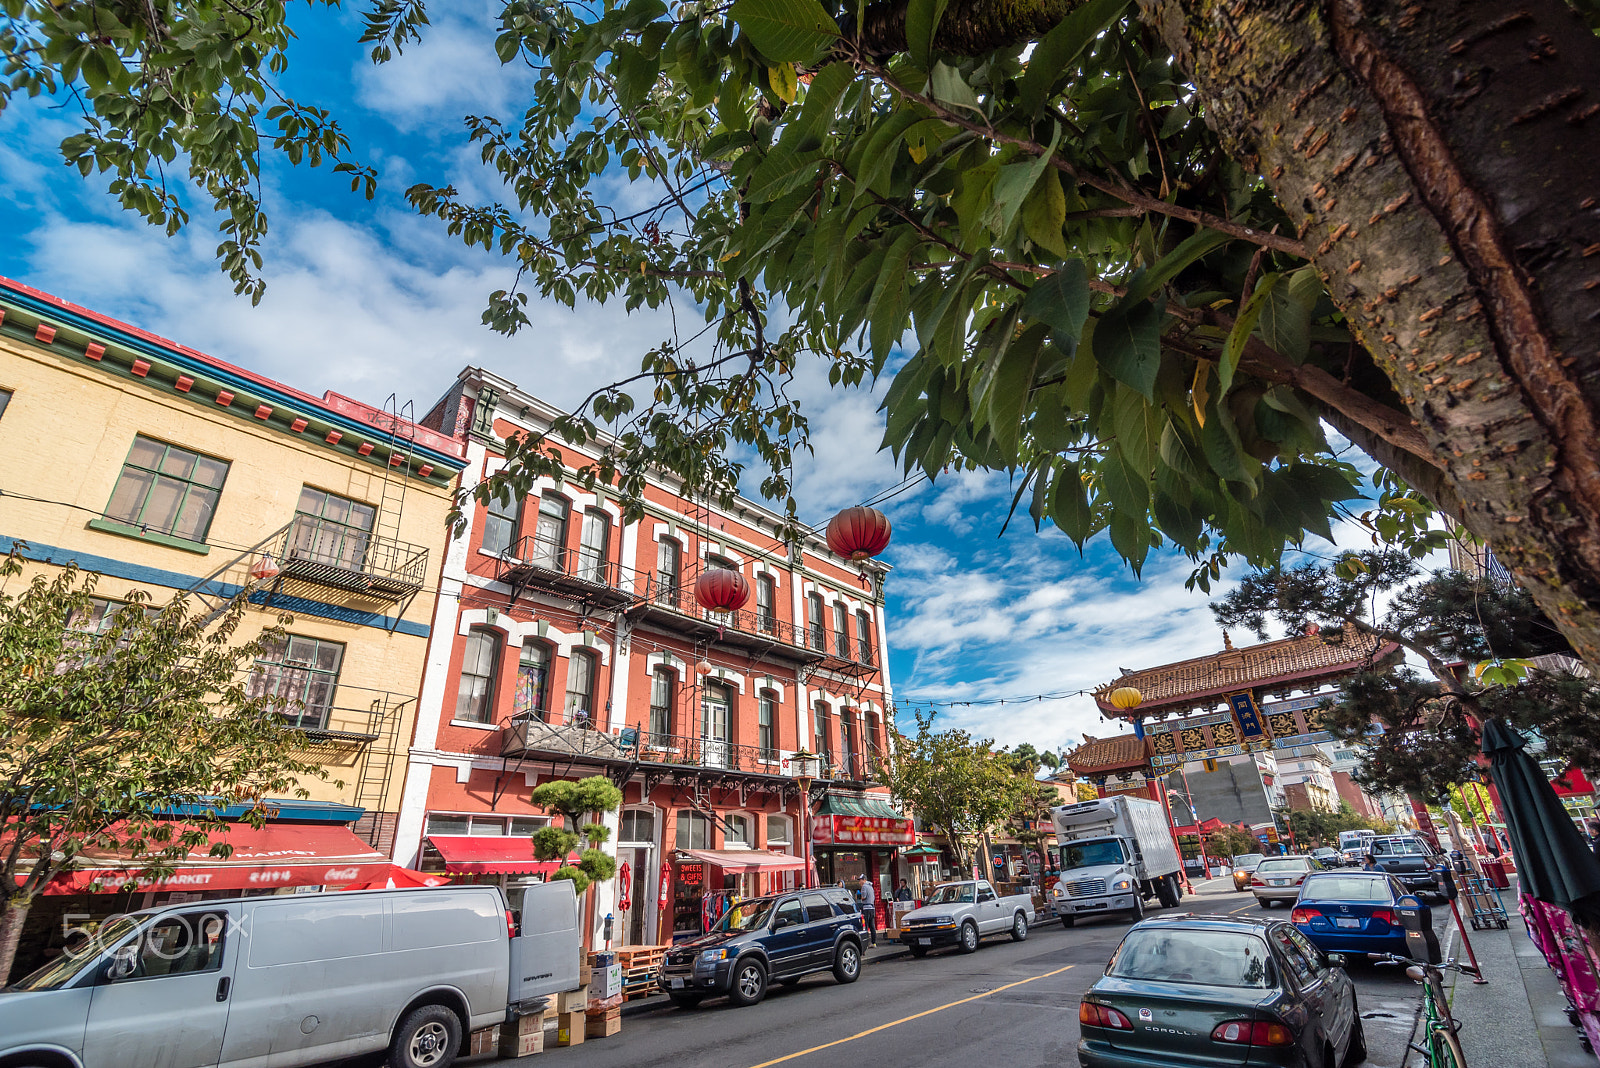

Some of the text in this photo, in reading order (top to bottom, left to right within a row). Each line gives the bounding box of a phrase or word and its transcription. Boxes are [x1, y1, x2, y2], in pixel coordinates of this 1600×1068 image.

[680, 864, 702, 872] SWEETS
[157, 873, 213, 886] MARKET
[686, 872, 703, 881] GIFTS
